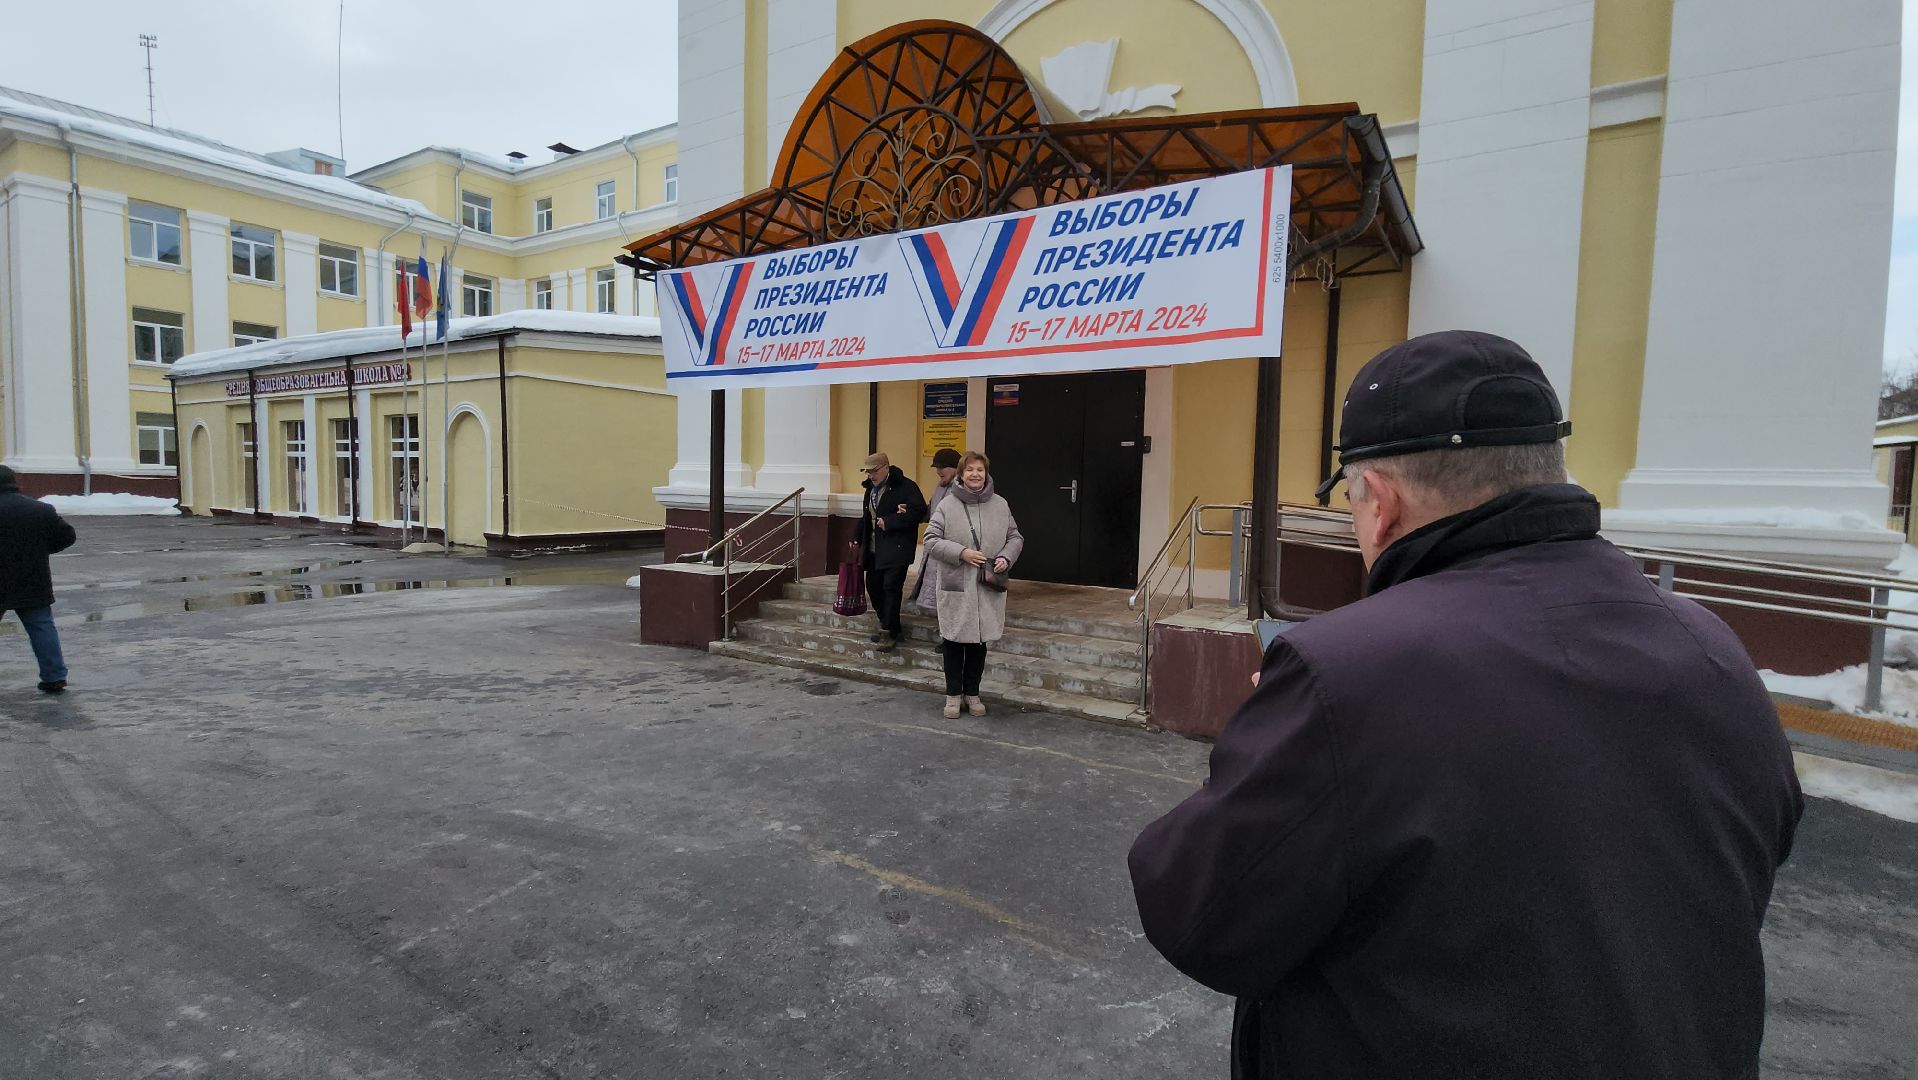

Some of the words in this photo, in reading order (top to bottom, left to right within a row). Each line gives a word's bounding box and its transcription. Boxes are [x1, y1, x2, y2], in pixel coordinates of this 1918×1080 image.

[1049, 187, 1200, 238] ВЫБОРЫ
[1033, 219, 1246, 276] ПРЕЗИДЕНТА
[1273, 213, 1286, 264] 5400x1000
[762, 245, 860, 281] ВЫБОРЫ
[1272, 266, 1282, 283] 625
[753, 272, 889, 310] ПРЕЗИДЕНТА
[1018, 272, 1146, 313] РОССИИ
[743, 311, 827, 340] РОССИИ
[1065, 309, 1144, 339] МАРТА
[1146, 302, 1208, 332] 2024
[775, 339, 826, 362] МАРТА
[826, 336, 866, 358] 2024
[354, 365, 388, 384] ШКОЛА
